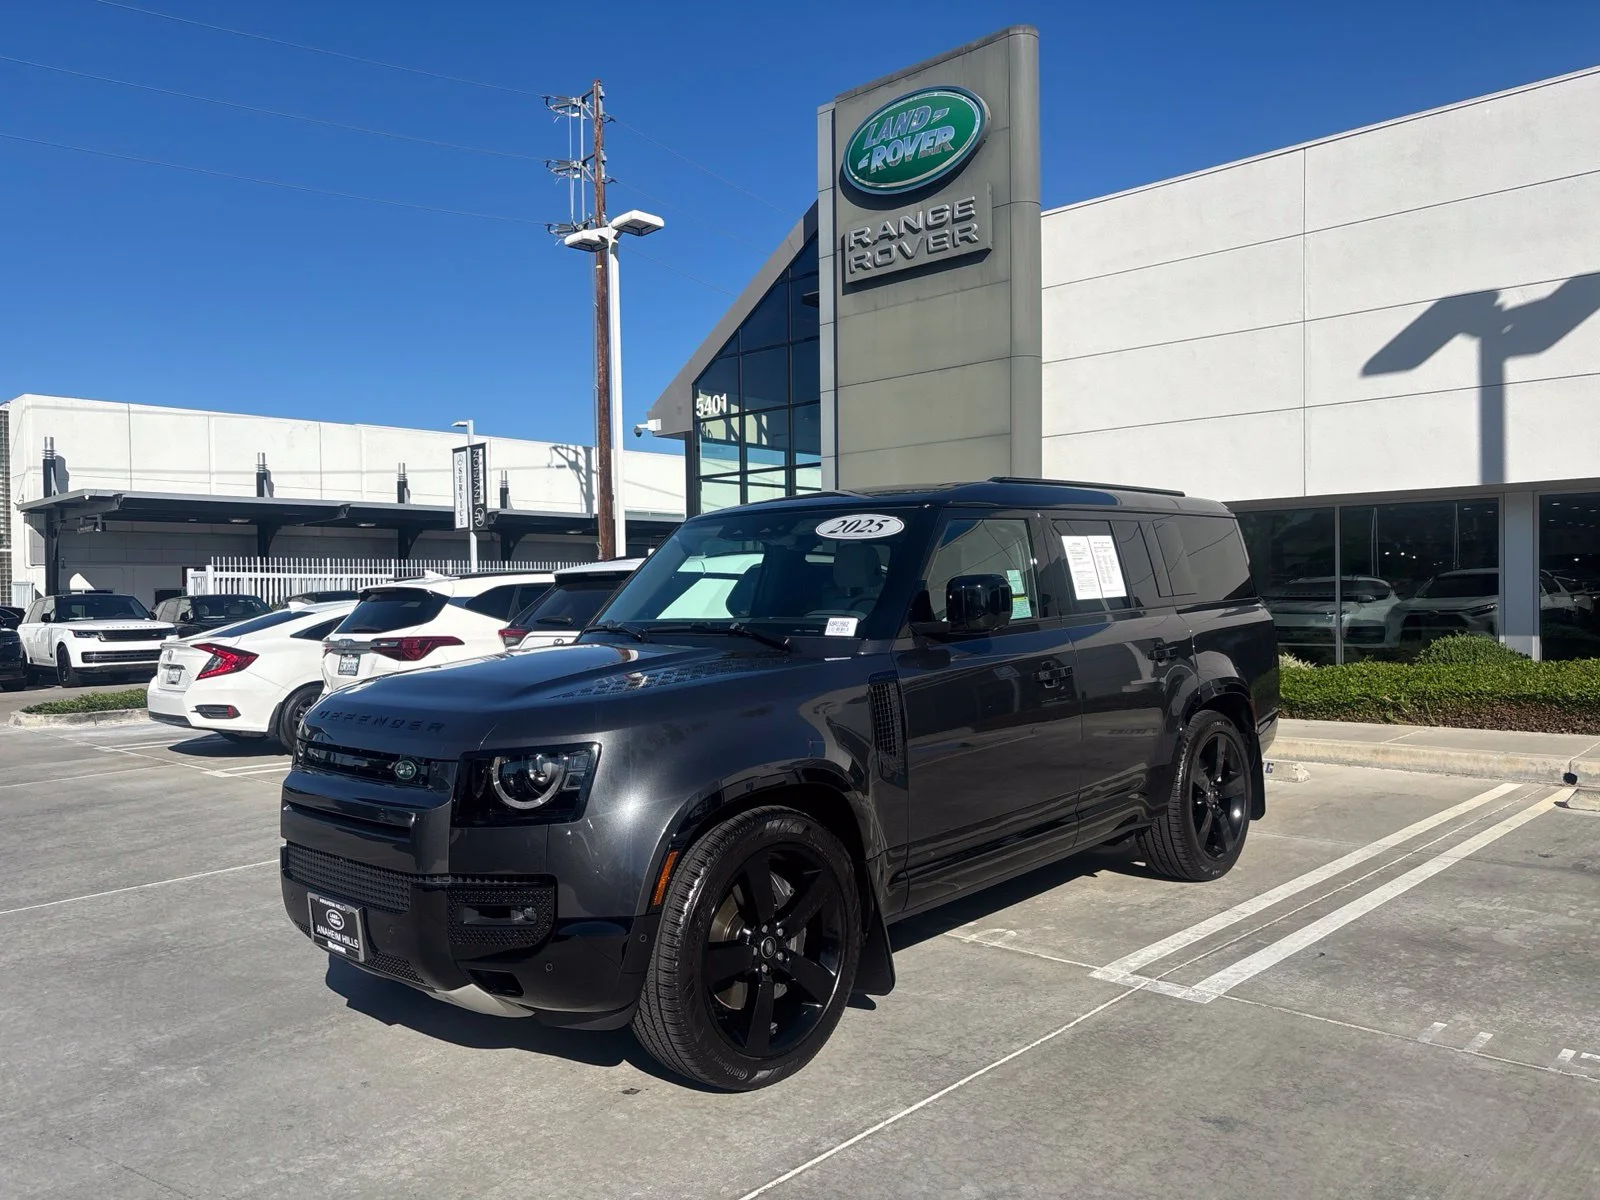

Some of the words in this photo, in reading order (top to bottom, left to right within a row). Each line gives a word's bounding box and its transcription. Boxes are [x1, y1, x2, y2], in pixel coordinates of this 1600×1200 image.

[863, 105, 931, 149] LAND
[870, 125, 955, 174] ROVER
[849, 196, 976, 250] RANGE
[850, 222, 979, 274] ROVER
[696, 393, 727, 417] 5401
[828, 519, 890, 534] 2025
[319, 710, 445, 733] DEFENDER
[316, 924, 342, 942] ANAHEIM
[341, 934, 359, 949] HILLS
